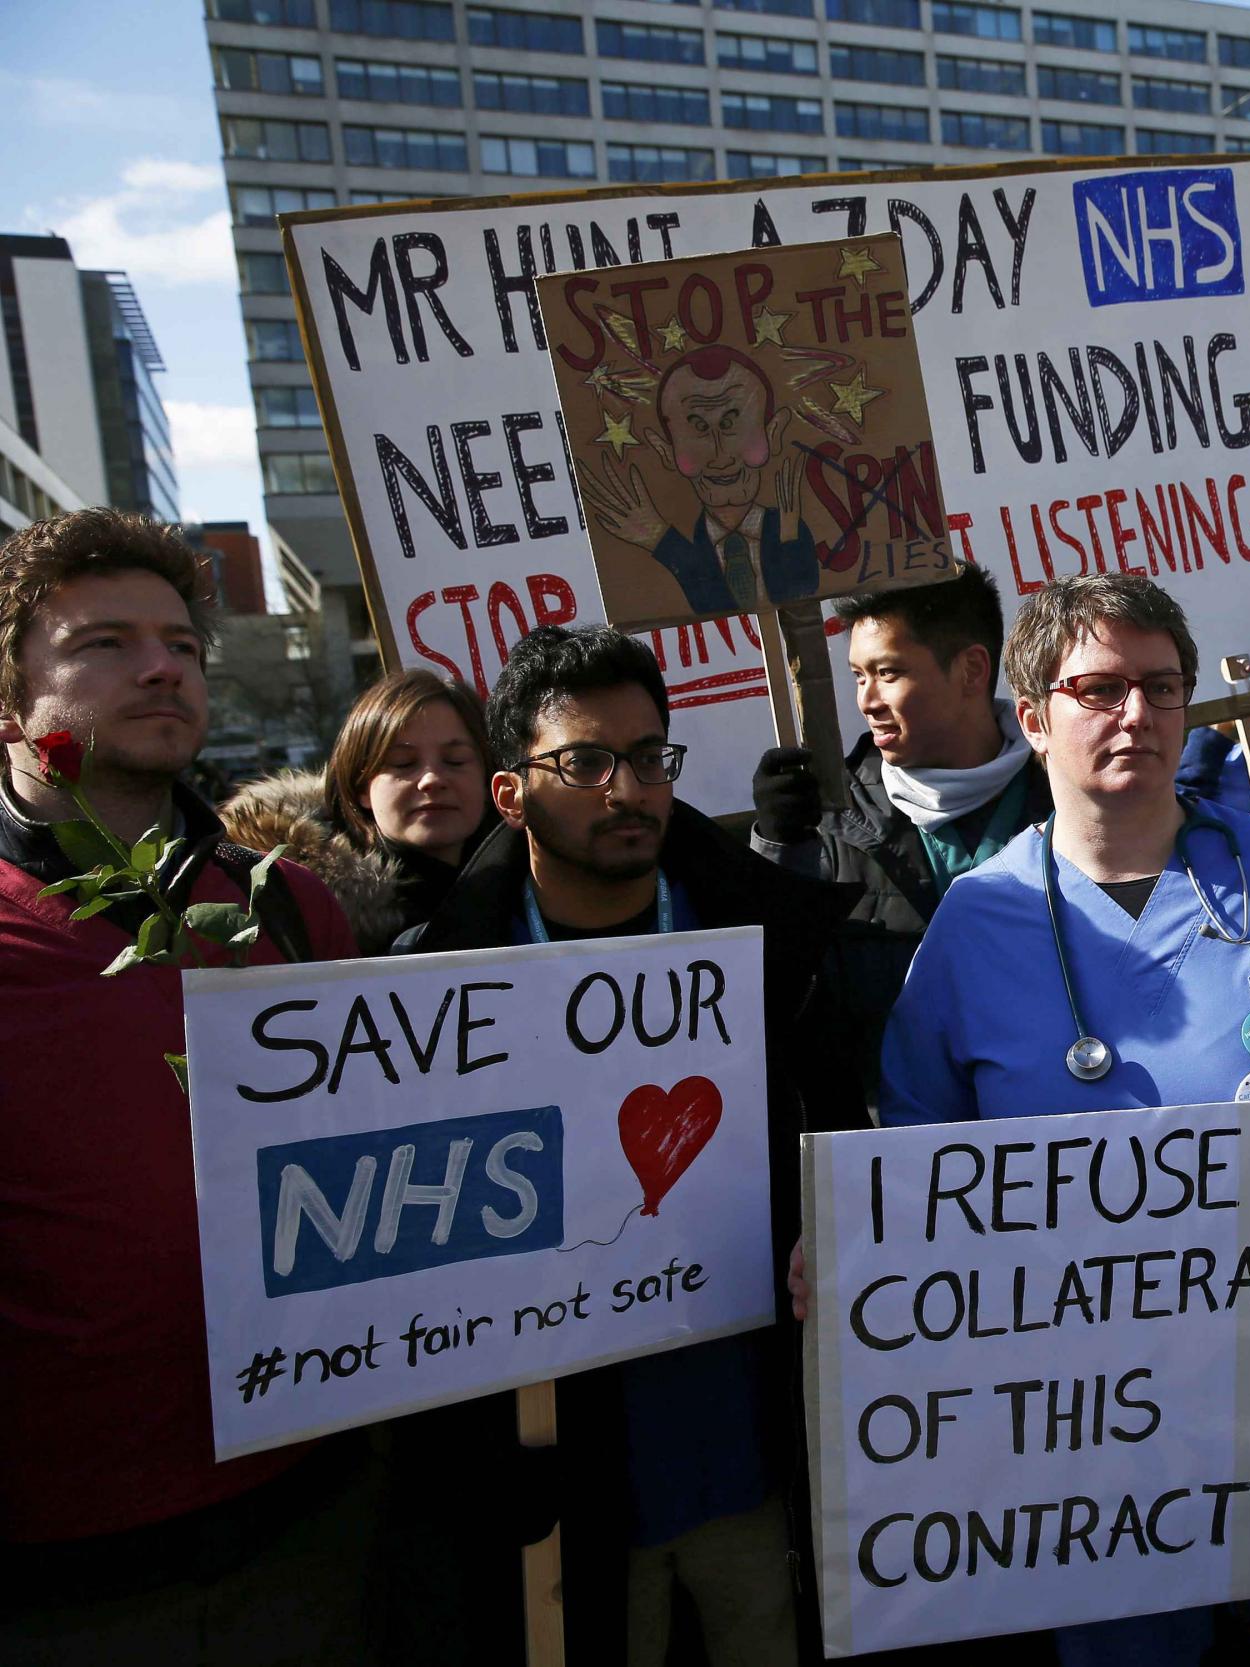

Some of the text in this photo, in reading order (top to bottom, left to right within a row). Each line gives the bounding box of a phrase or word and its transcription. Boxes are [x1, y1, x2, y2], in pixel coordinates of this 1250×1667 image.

[322, 231, 475, 372] MR
[888, 187, 1037, 314] DAY
[1086, 181, 1235, 293] NHS
[557, 263, 907, 372] STOP THE
[375, 409, 584, 559] NEE
[796, 440, 945, 573] SPIN
[857, 540, 950, 584] LIES
[406, 573, 577, 700] STOP
[236, 959, 732, 1103] SAVE OUR
[273, 1130, 545, 1277] NHS
[870, 1156, 885, 1245] I
[925, 1128, 1241, 1243] REFUSE
[236, 1257, 711, 1404] #not fair not safe
[857, 1367, 1162, 1464] OF THIS
